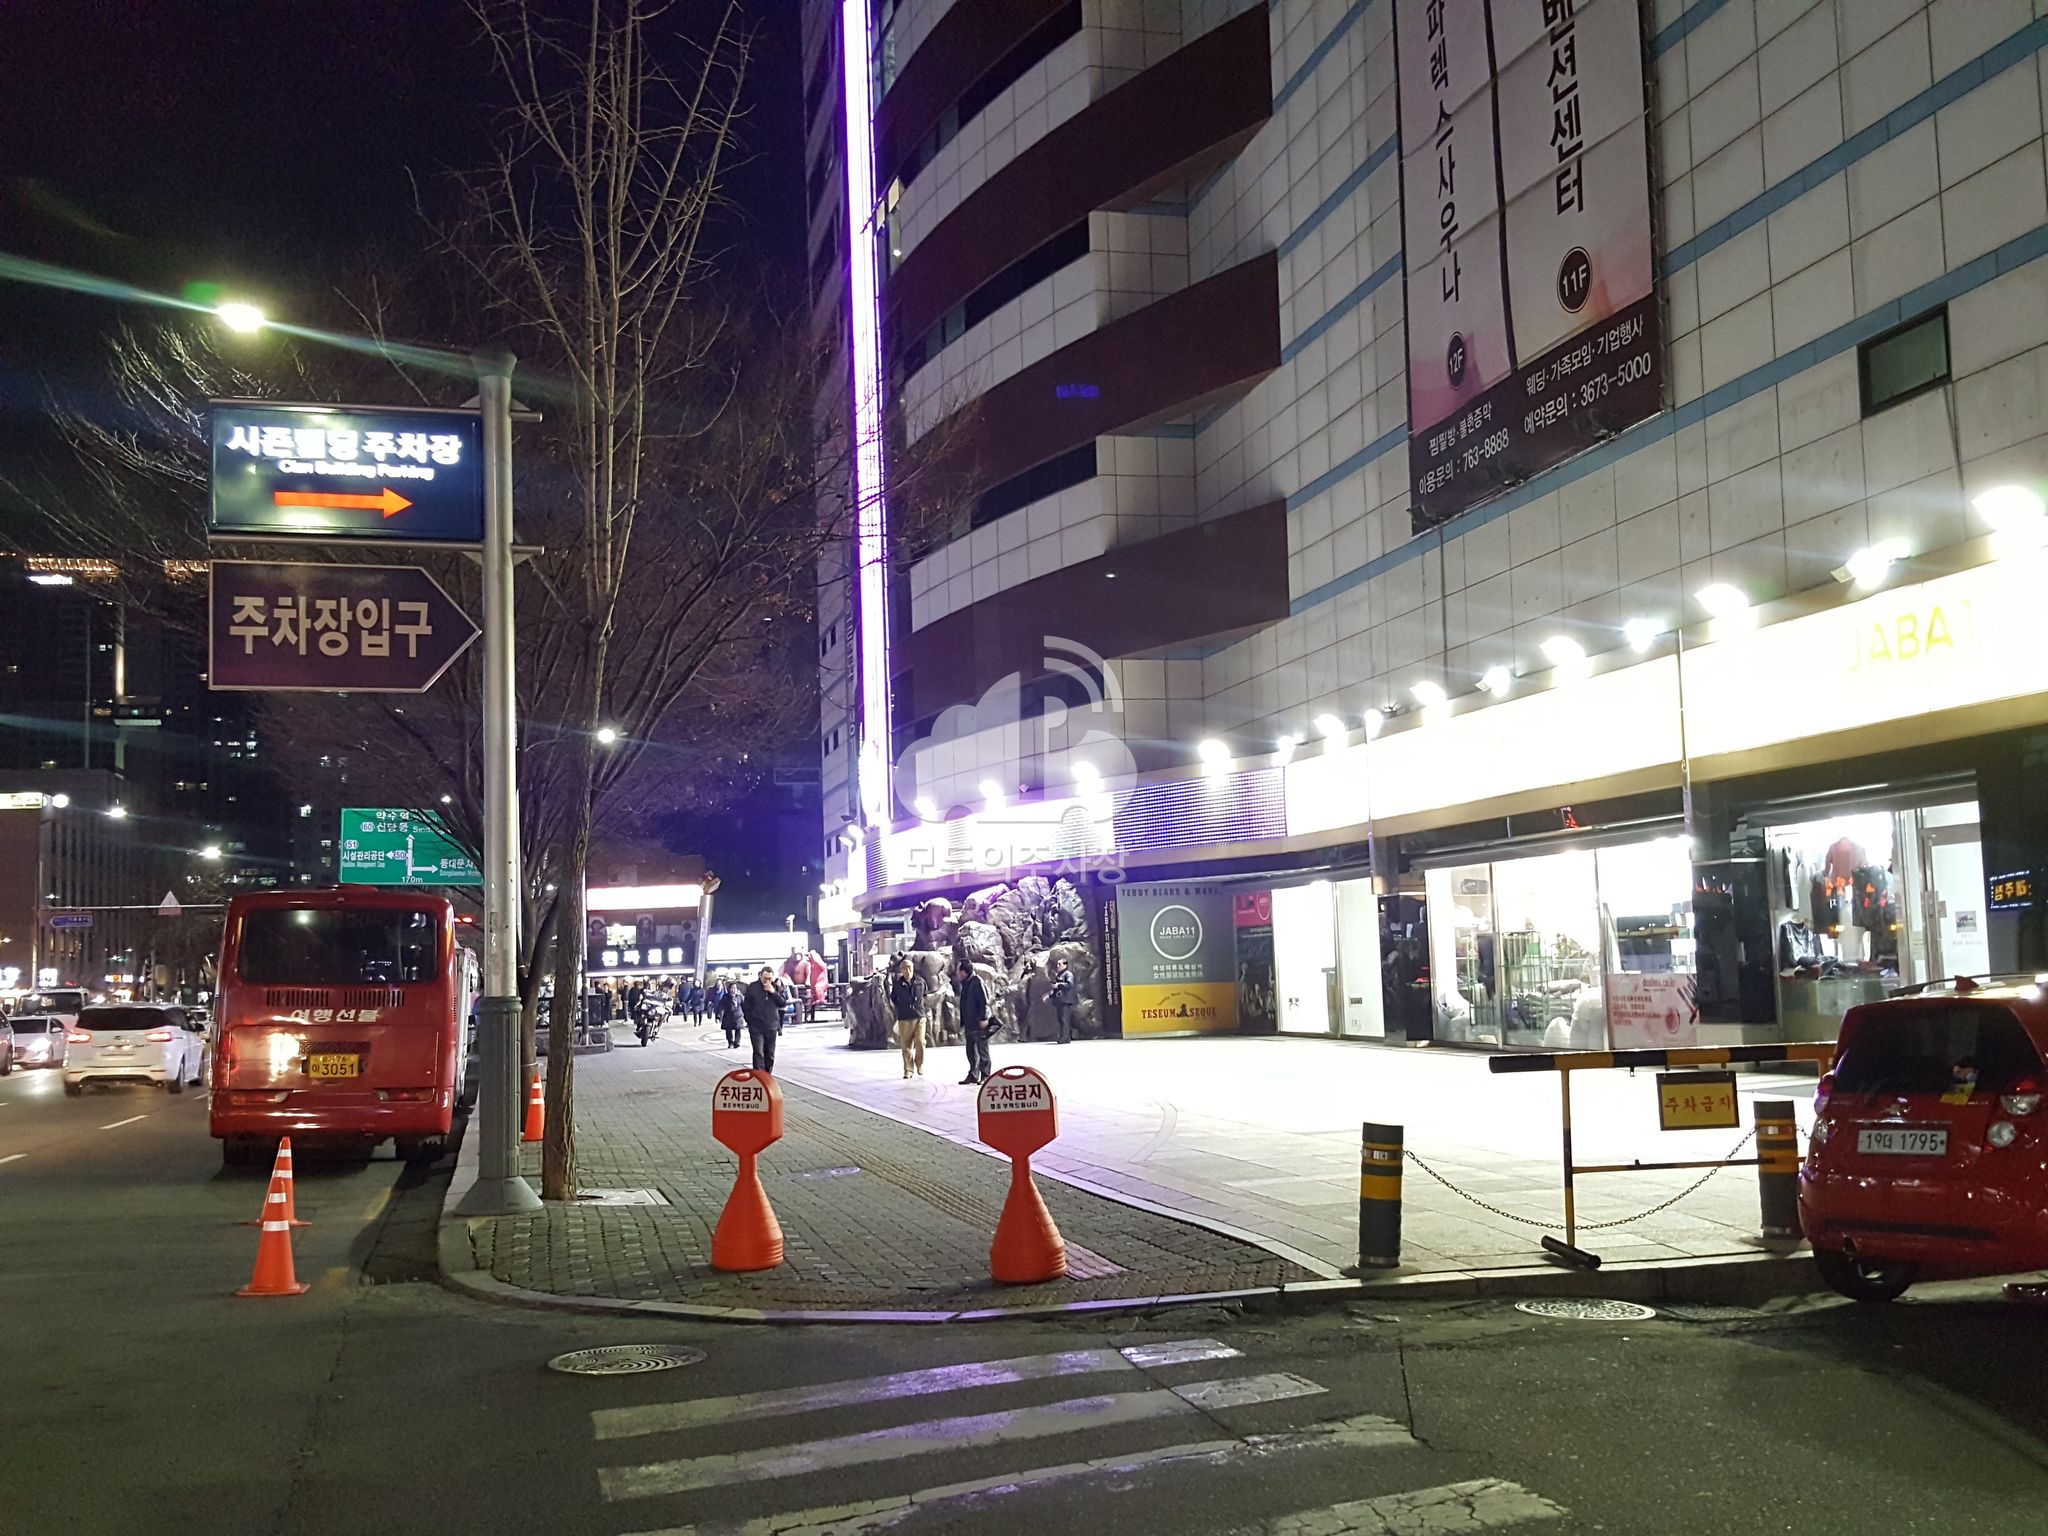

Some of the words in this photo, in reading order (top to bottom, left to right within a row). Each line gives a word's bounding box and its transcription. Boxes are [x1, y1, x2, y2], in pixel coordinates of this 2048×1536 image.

[1561, 263, 1588, 298] 11F
[1448, 347, 1464, 376] 12F
[1523, 392, 1569, 435] 예약문의
[1579, 351, 1652, 407] 3673-5000
[362, 430, 463, 466] 주차장
[1418, 461, 1454, 496] 이용문의
[1461, 427, 1510, 474] 763-8888
[229, 596, 433, 659] 주차장입구
[376, 822, 409, 833] 신당동
[342, 850, 385, 862] 시설관리공단
[440, 859, 478, 870] 동대문시
[1121, 888, 1150, 897] TEDDY
[1159, 926, 1196, 936] JABA11
[290, 1009, 380, 1023] 여행선물
[1141, 1008, 1178, 1019] TESEUM
[1189, 1006, 1217, 1019] SEOUL
[322, 1064, 354, 1075] 3051
[1664, 1094, 1732, 1114] 주차금지
[1900, 1132, 1938, 1151] 1795
